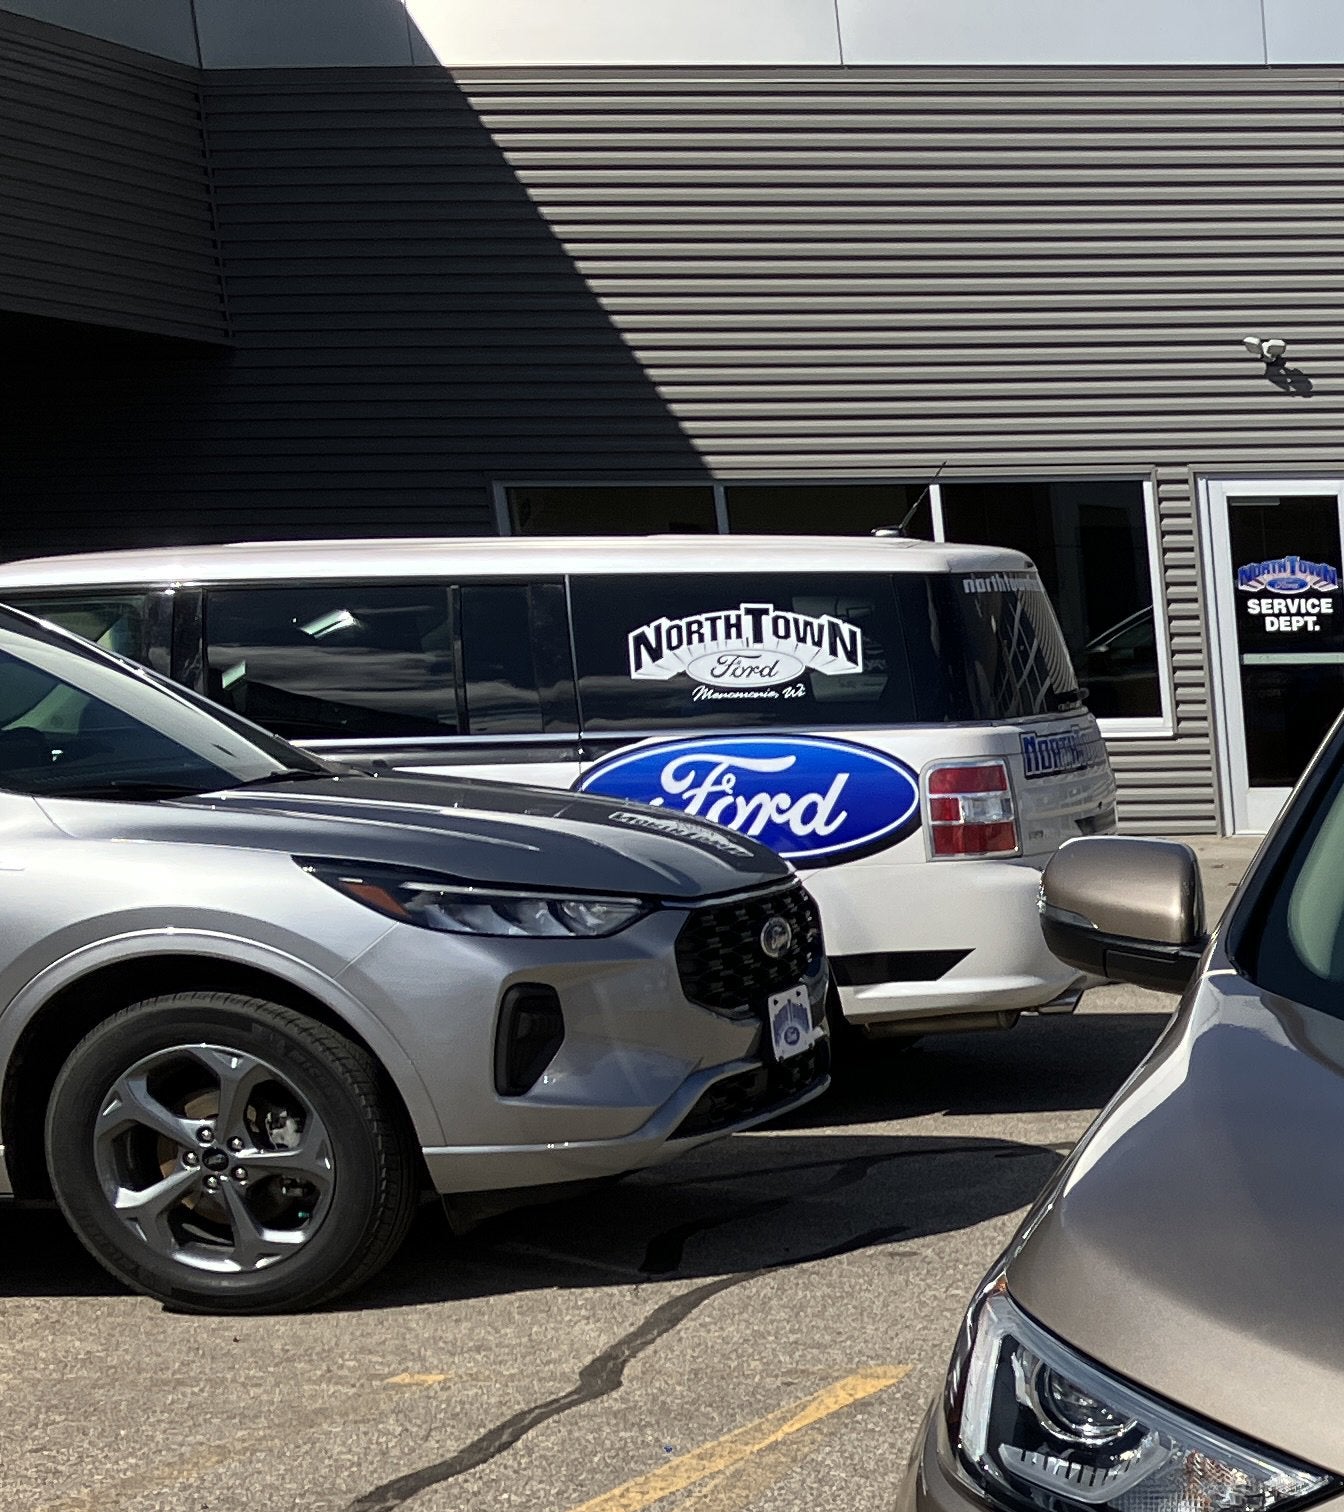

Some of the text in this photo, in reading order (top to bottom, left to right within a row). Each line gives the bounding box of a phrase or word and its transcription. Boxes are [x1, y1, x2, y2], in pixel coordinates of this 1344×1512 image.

[1246, 598, 1334, 615] SERVICE
[1264, 616, 1321, 632] DEPT.
[710, 654, 780, 679] Ford
[649, 753, 850, 836] Ford
